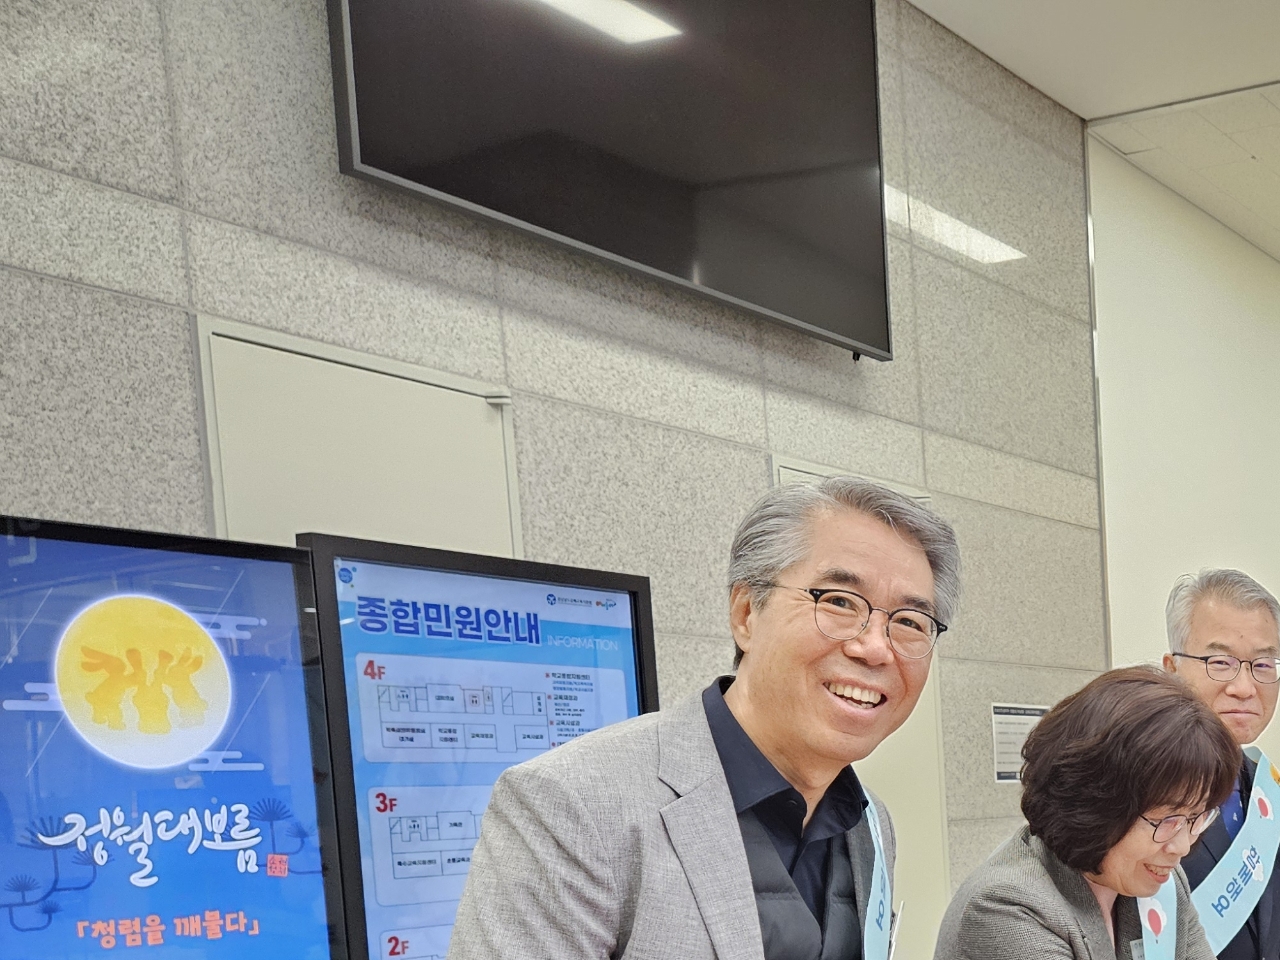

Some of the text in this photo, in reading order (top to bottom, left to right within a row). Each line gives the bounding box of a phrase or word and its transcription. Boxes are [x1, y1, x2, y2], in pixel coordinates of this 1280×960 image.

[356, 595, 541, 645] 종합민원안내
[546, 634, 619, 651] INFORMATION
[363, 659, 386, 680] 4F
[375, 792, 398, 813] 3F
[37, 803, 263, 888] 정월대보름
[1210, 844, 1262, 919] 함께해요
[75, 909, 260, 949] 「청렴을 깨물다」
[387, 935, 410, 957] 2F
